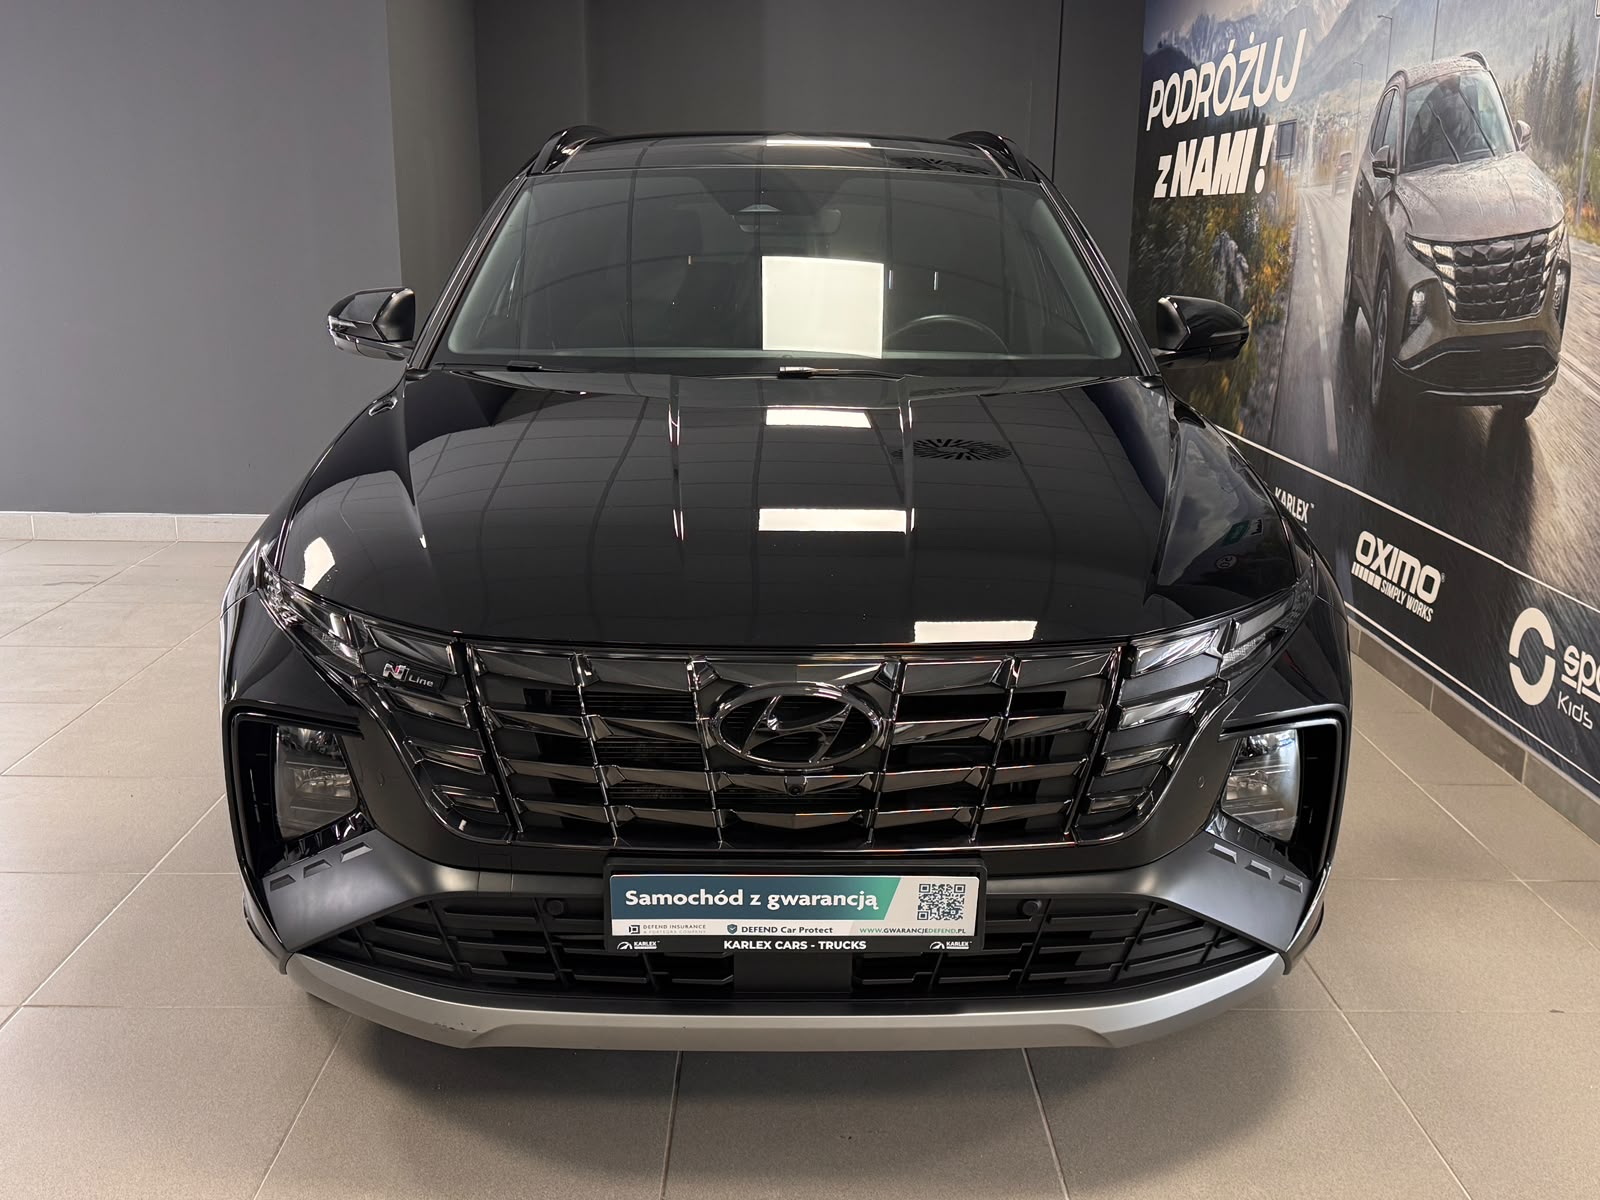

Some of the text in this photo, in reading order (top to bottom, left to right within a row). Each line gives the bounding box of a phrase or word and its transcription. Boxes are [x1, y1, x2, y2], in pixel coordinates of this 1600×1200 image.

[1146, 28, 1307, 131] PODRÓŻUJ
[1355, 530, 1441, 604] OXIMO
[1380, 580, 1434, 622] SIMPLY WORKS
[408, 674, 434, 688] Line
[1563, 645, 1600, 695] sp
[1557, 690, 1593, 730] Kids
[625, 888, 879, 911] Samochód z gwarancją
[723, 940, 772, 950] KARLEX
[774, 940, 808, 950] CARS
[818, 940, 867, 950] TRUCKS
[798, 926, 834, 934] Protect
[859, 927, 966, 935] WWW.GWARANCJEDEFEND.PL
